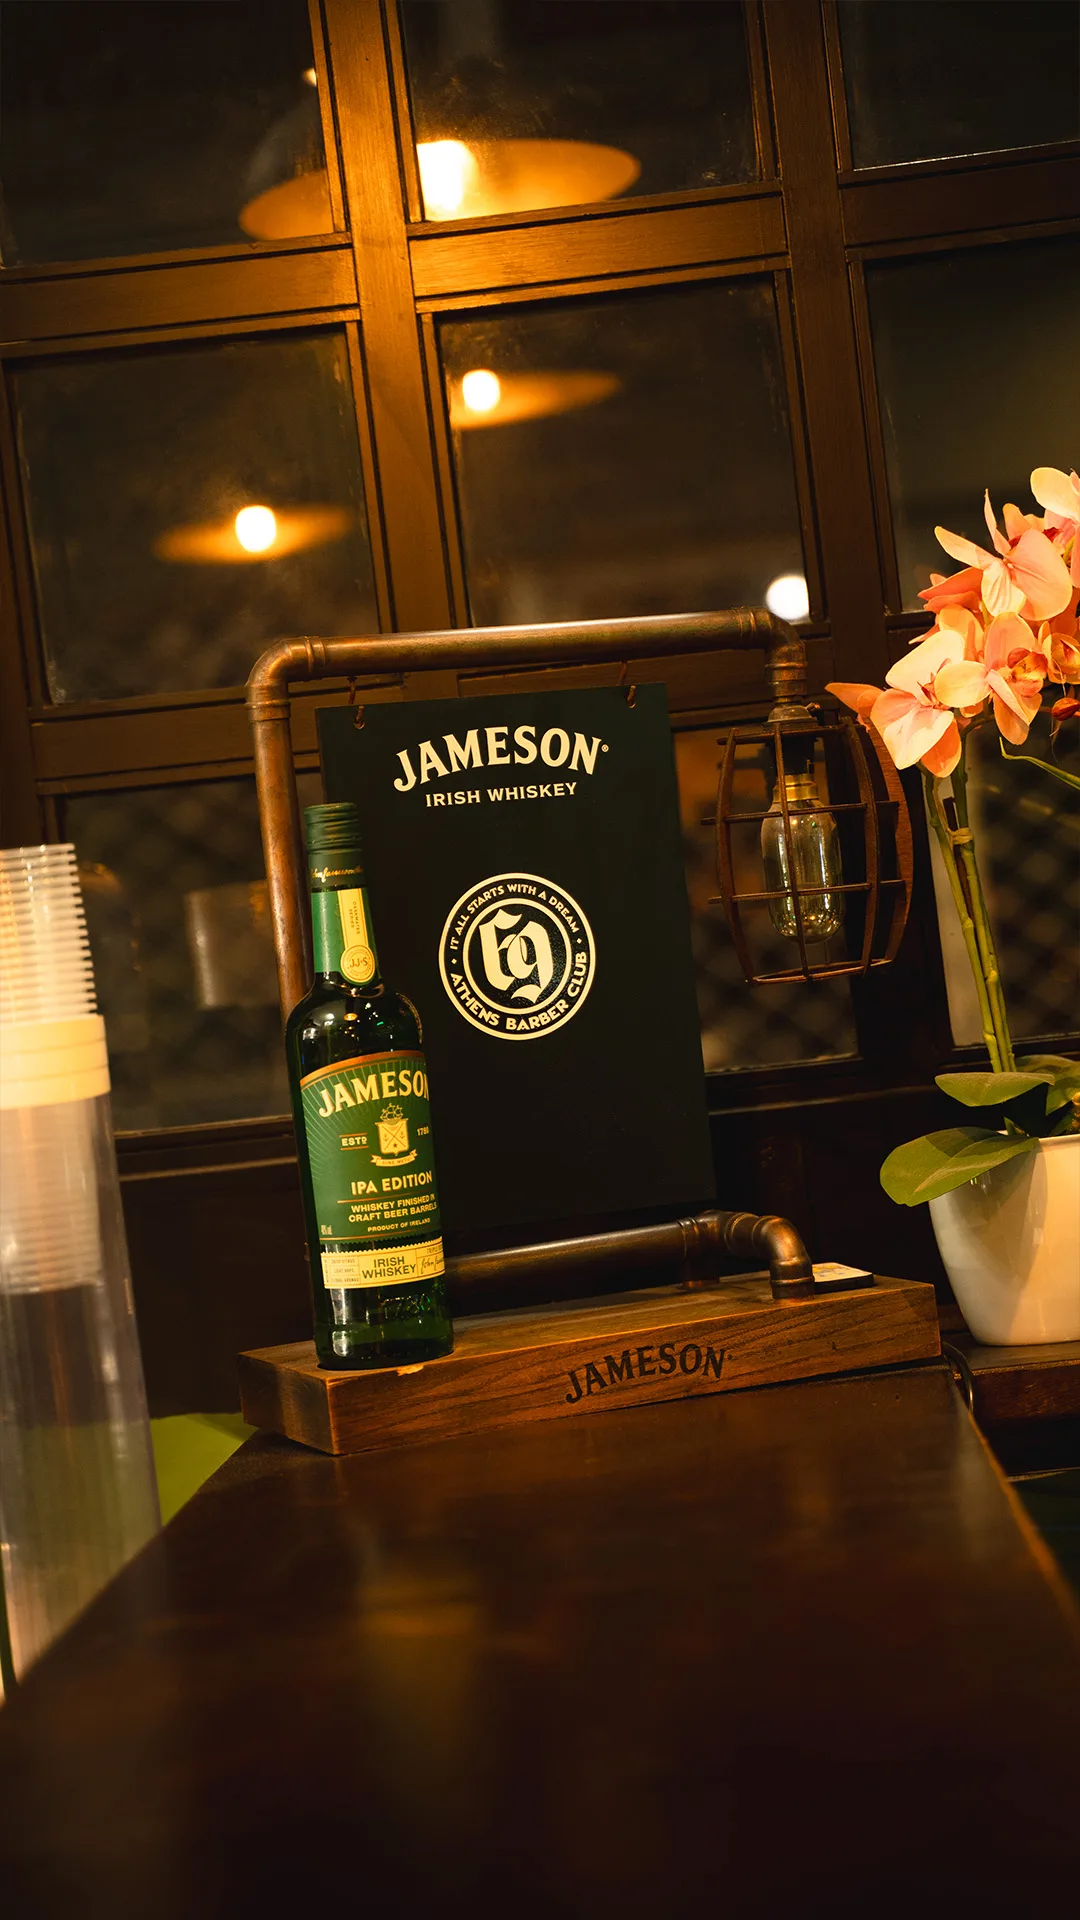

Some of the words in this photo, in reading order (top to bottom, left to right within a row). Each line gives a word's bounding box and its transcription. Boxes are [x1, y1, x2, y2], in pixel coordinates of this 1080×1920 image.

[425, 790, 481, 807] IRISH
[487, 782, 577, 802] WHISKEY
[507, 884, 537, 896] WITH
[538, 890, 547, 900] A
[467, 885, 505, 915] STARTS
[548, 896, 580, 933] DREAM
[454, 915, 470, 936] ALL
[450, 937, 459, 950] IT
[450, 973, 500, 1026] ATHENS
[505, 999, 570, 1031] BARBER
[567, 951, 587, 998] CLUB
[351, 1180, 378, 1196] IPA
[382, 1170, 433, 1192] EDITION
[348, 1212, 381, 1223] CRAFT
[383, 1208, 409, 1219] BEER
[410, 1202, 437, 1215] BARRELS
[351, 1201, 395, 1213] WHISKEY
[397, 1195, 430, 1208] FINISHED
[367, 1223, 399, 1233] PRODUCT
[409, 1217, 431, 1227] IRELAND
[362, 1264, 417, 1279] WHISKEY
[373, 1256, 405, 1268] IRISH
